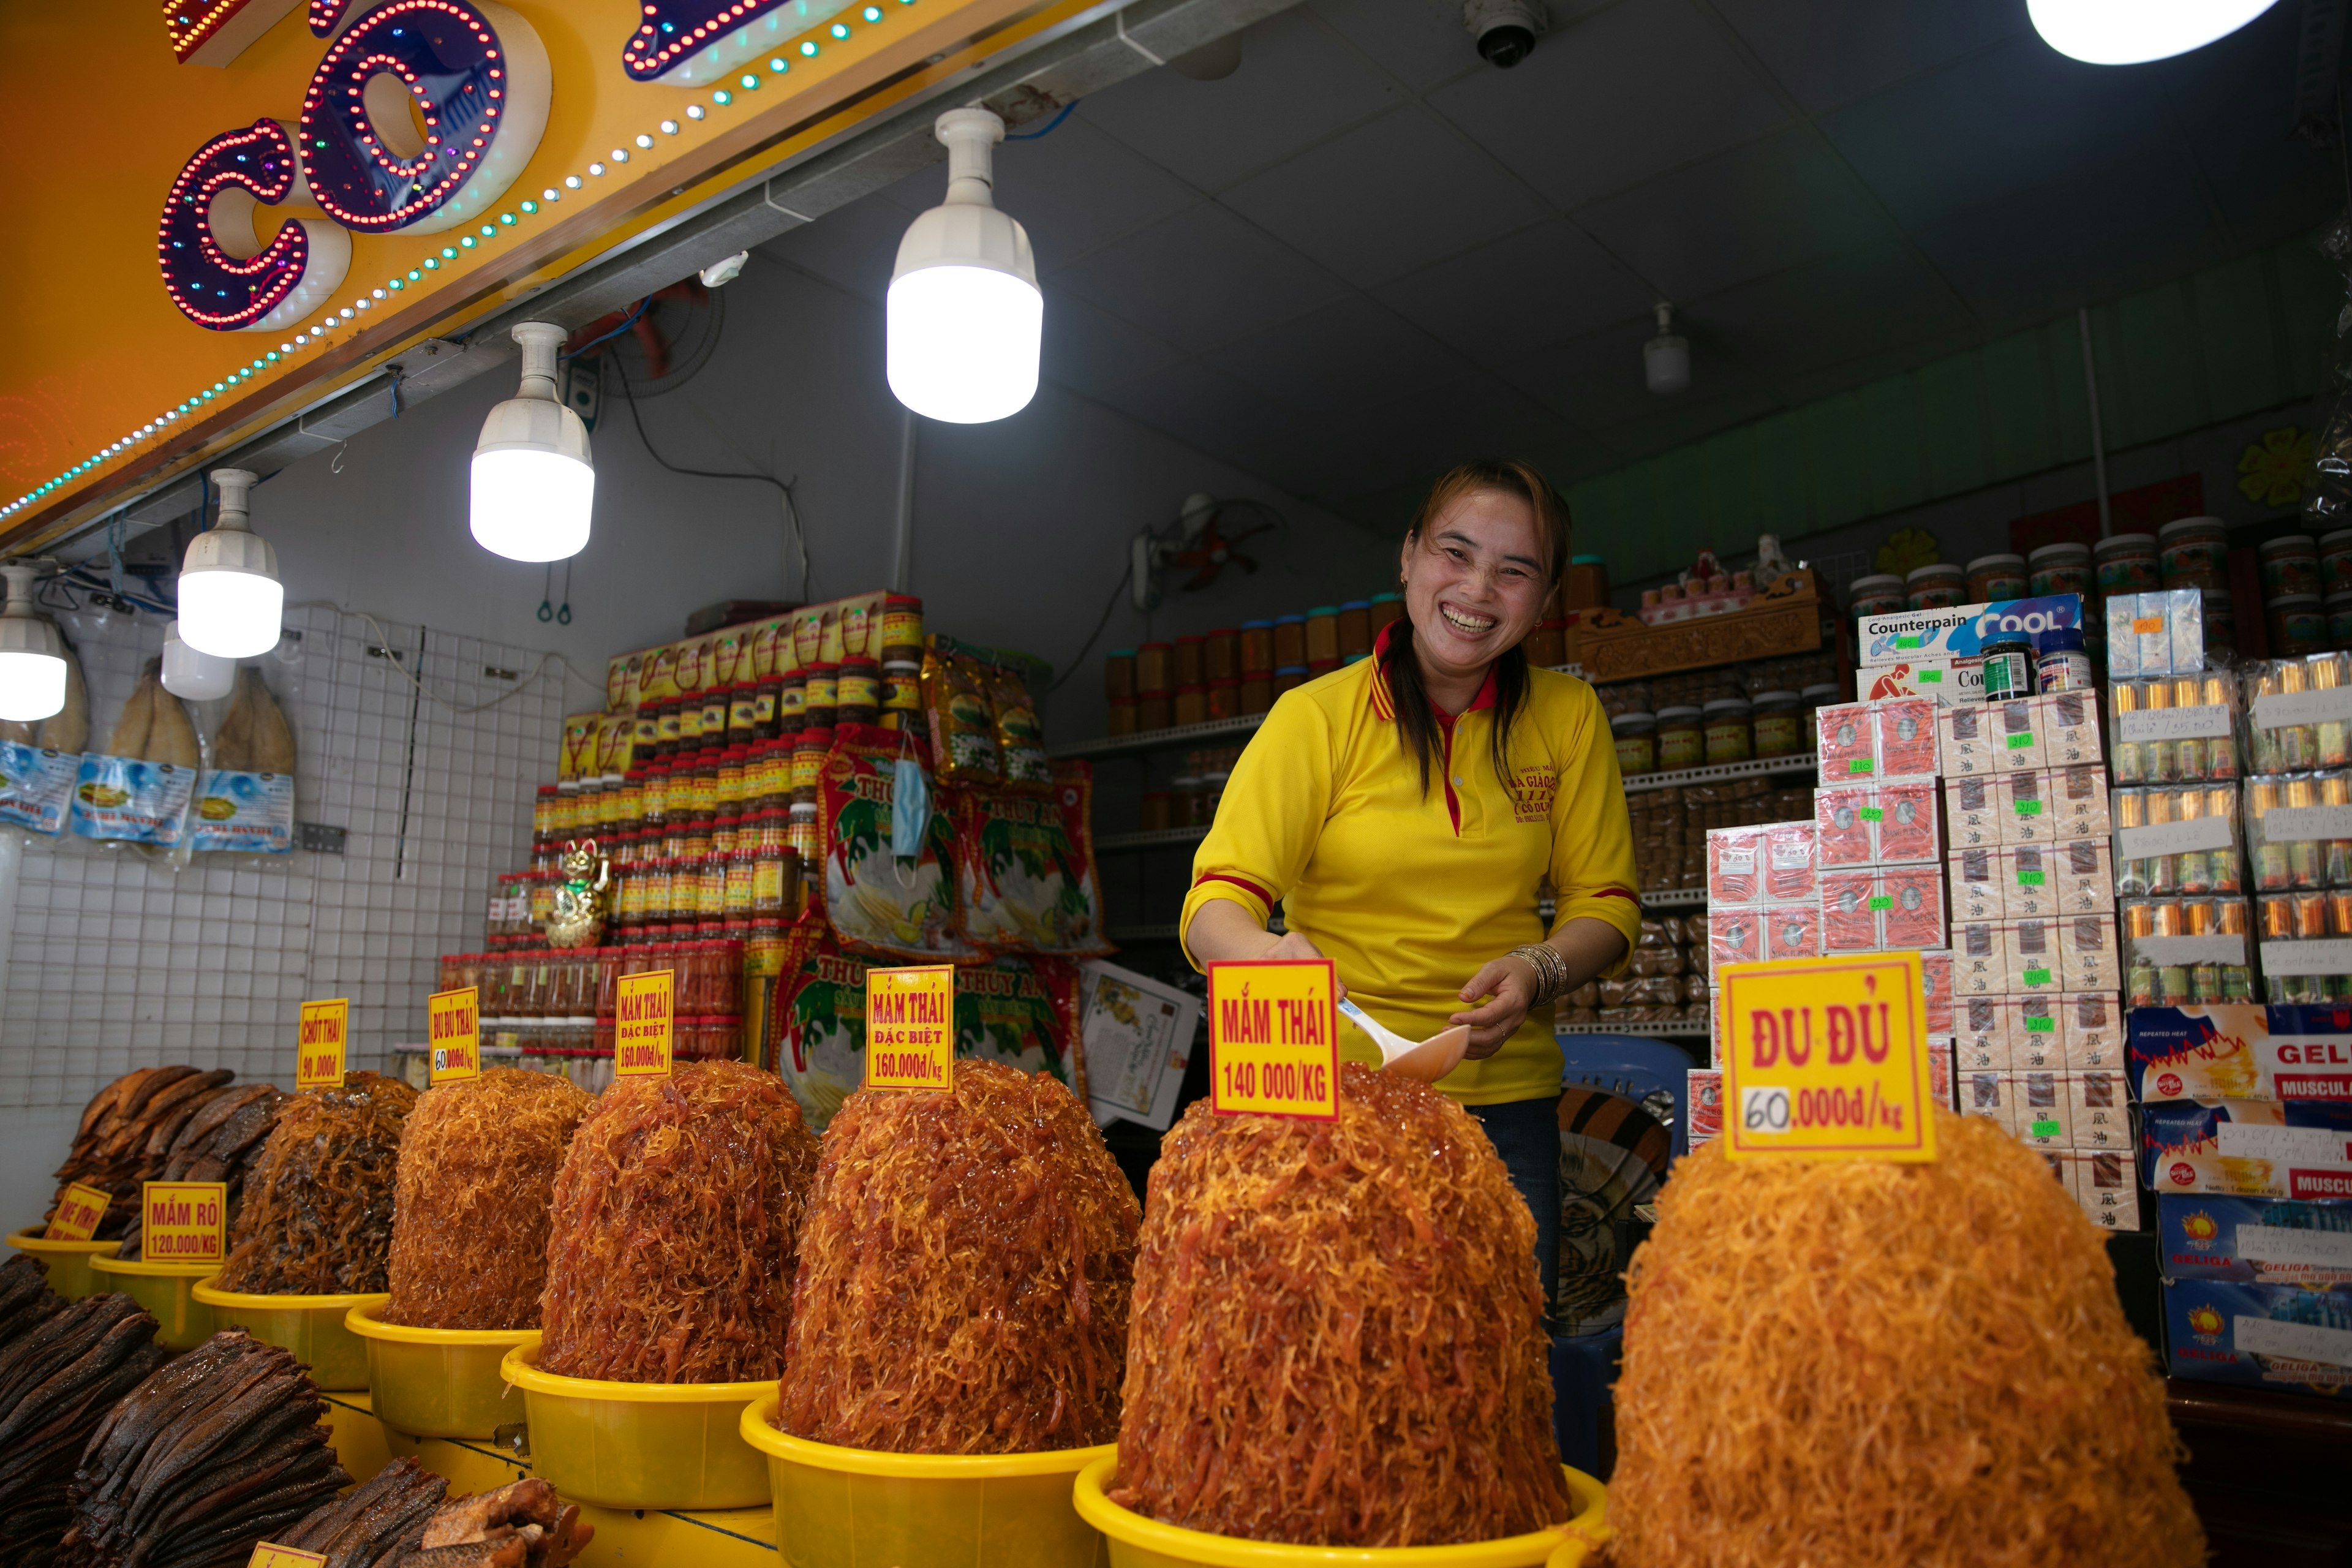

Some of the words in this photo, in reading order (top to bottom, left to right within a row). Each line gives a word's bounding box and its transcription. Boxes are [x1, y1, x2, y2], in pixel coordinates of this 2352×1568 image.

[1869, 614, 1967, 635] Counterpain
[2013, 735, 2029, 747] 210
[1825, 750, 1844, 760] IANG
[1852, 762, 1870, 771] 220
[1521, 801, 1533, 813] CÔ
[2018, 802, 2038, 812] 210
[1863, 810, 1881, 819] 220
[1883, 826, 1901, 837] SIANG
[2021, 873, 2041, 883] 210
[1871, 898, 1889, 907] 220
[1715, 949, 1732, 960] SIANG
[1746, 949, 1757, 959] OIL
[1771, 948, 1790, 959] SIANG
[1804, 946, 1815, 957] OIL
[2027, 971, 2045, 981] 210
[620, 981, 642, 1022] MẮM
[644, 982, 667, 1020] THÁI
[873, 975, 905, 1023] MẮM
[908, 981, 944, 1023] THÁI
[433, 1012, 443, 1040] ĐU
[456, 998, 473, 1037] THÁI
[1222, 981, 1270, 1044] MẮM
[1278, 986, 1325, 1046] THÁI
[303, 1008, 322, 1044] CHỐT
[323, 1010, 341, 1043] THÁI
[1751, 1006, 1811, 1069] ĐU
[1825, 973, 1890, 1066] ĐỦ
[2030, 1019, 2051, 1030] 210
[621, 1024, 641, 1040] ĐẶC
[643, 1021, 665, 1039] BIỆT
[875, 1026, 905, 1047] ĐẶC
[908, 1026, 943, 1047] BIỆT
[620, 1041, 665, 1068] 160.000đ/kg
[303, 1056, 312, 1079] 90
[875, 1049, 942, 1082] 160.000đ/kg
[1224, 1061, 1256, 1099] 140
[1262, 1059, 1326, 1102] 000/KG
[2035, 1125, 2055, 1133] 210
[153, 1194, 191, 1226] MẮM
[197, 1197, 217, 1227] RÔ
[152, 1233, 217, 1254] 120.000/KG
[2173, 1254, 2233, 1268] GELIGA
[2178, 1348, 2239, 1363] GELIGA
[2271, 1362, 2319, 1373] GELIGA
